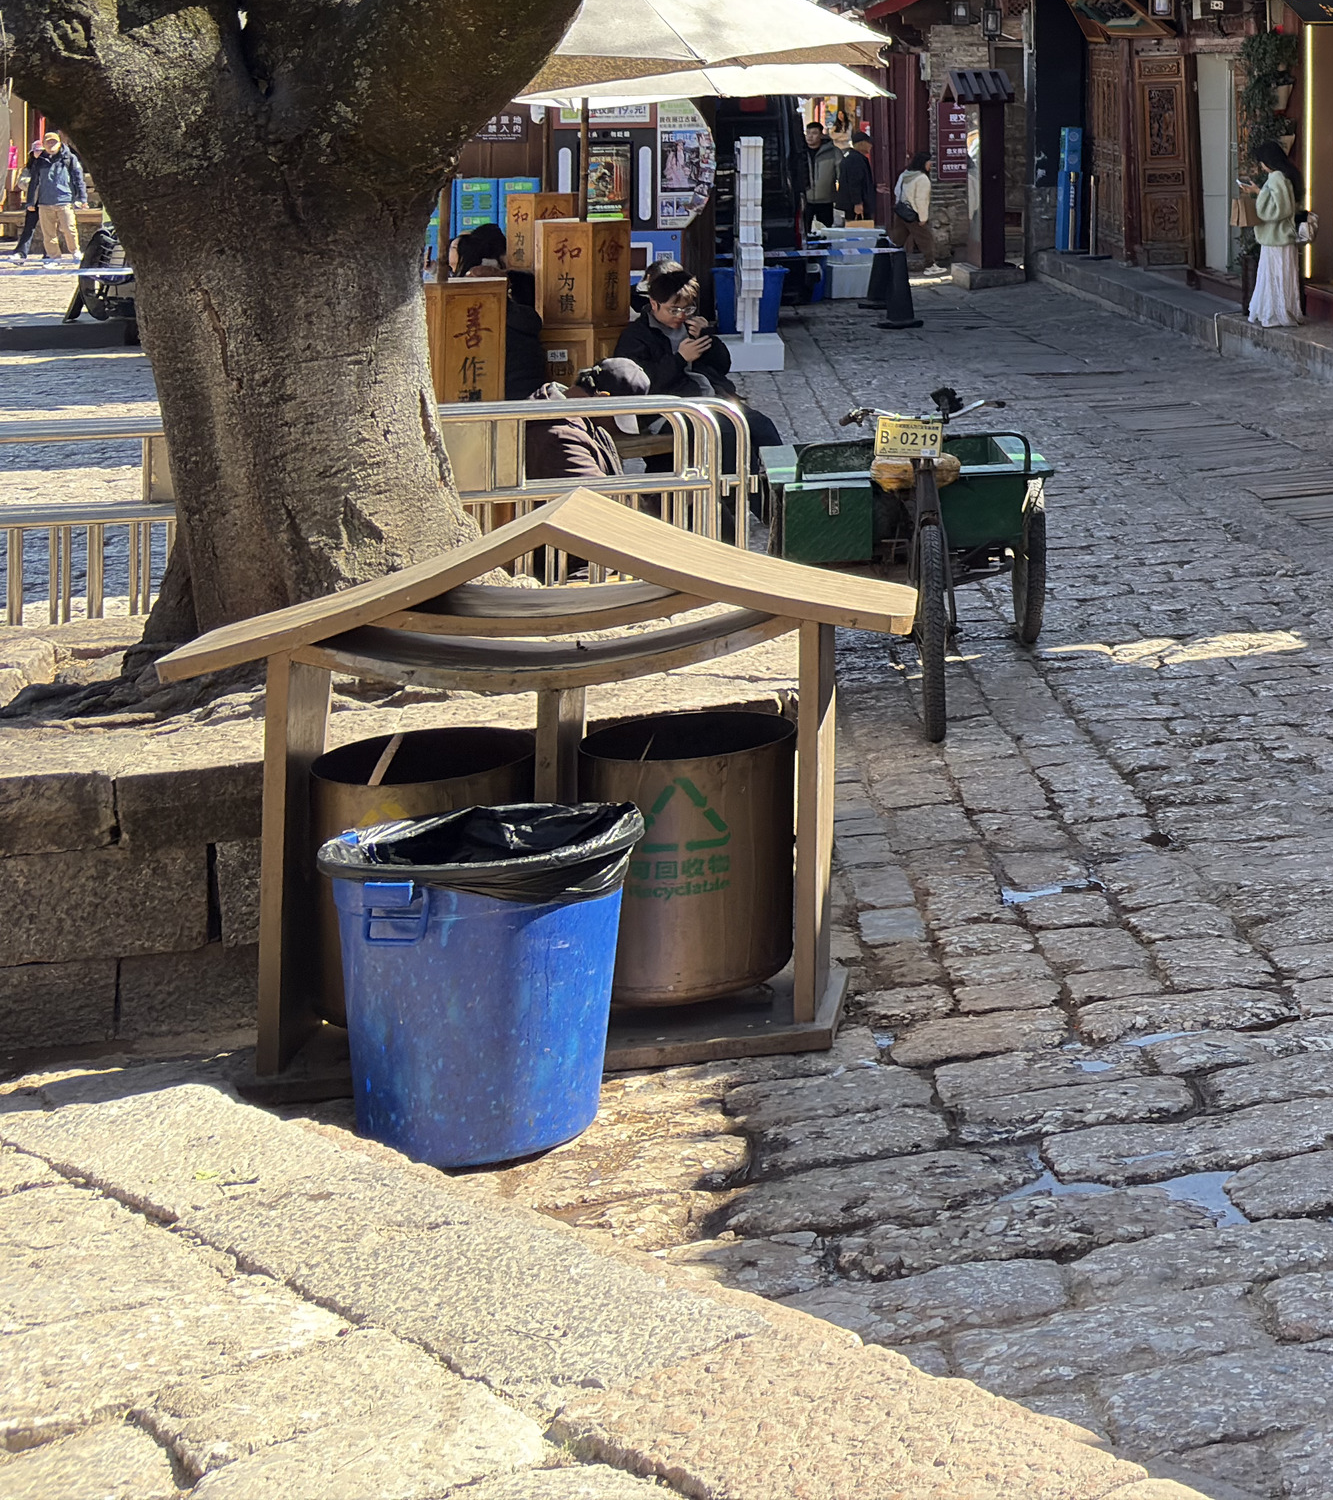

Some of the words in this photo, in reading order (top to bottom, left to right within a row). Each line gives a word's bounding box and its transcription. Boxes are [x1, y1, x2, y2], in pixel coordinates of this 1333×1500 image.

[554, 238, 582, 313] 和为贵
[631, 854, 731, 880] 可回收物
